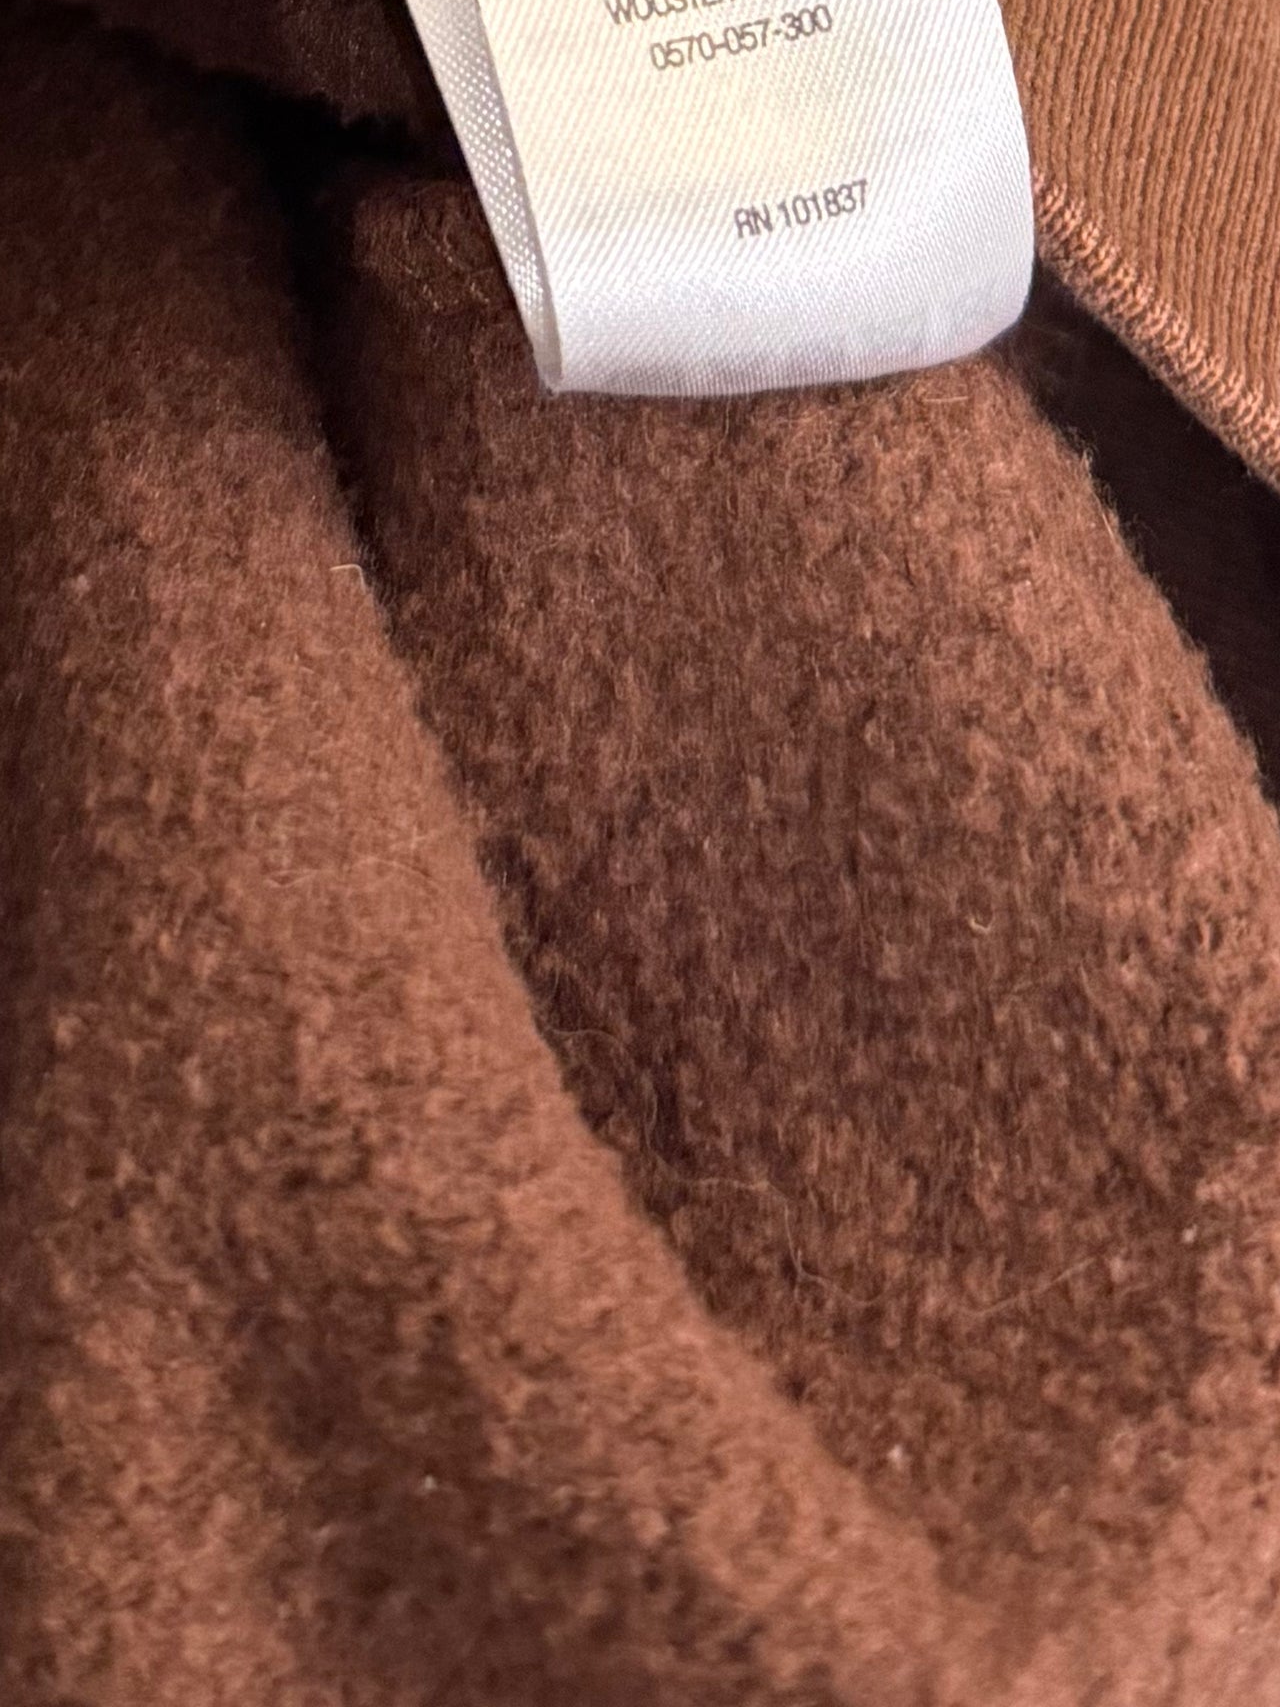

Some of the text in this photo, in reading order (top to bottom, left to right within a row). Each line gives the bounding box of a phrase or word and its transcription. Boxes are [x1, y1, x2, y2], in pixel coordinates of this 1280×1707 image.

[649, 3, 833, 72] 0570-057-300
[733, 178, 868, 239] RN 101837
